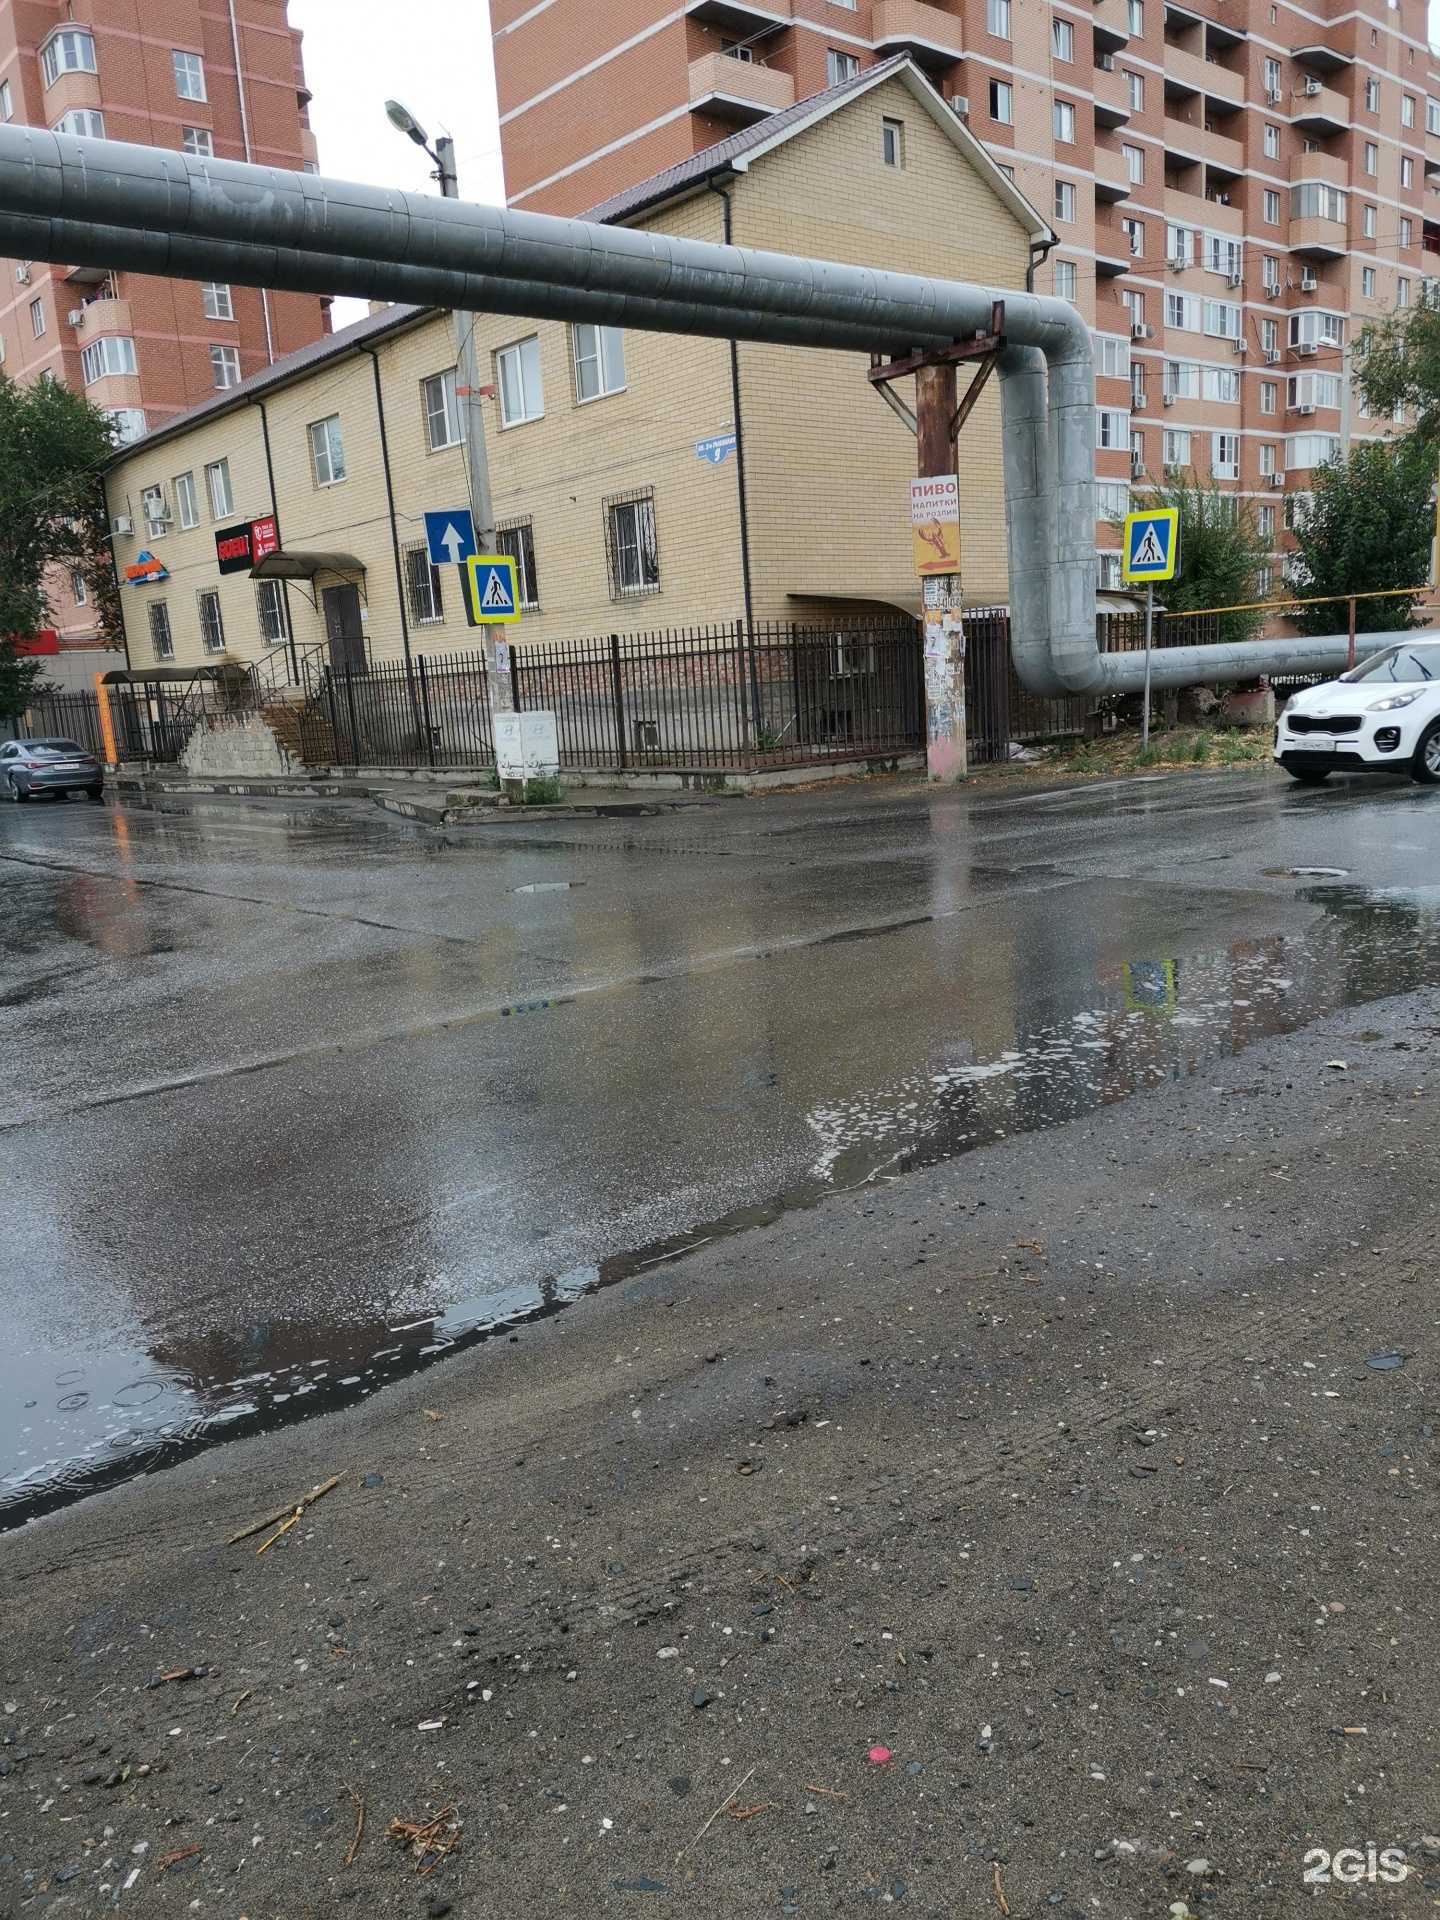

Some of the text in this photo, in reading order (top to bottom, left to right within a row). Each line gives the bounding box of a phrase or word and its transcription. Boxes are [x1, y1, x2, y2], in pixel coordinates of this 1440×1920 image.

[912, 482, 956, 497] ПИВО
[912, 498, 957, 510] НАПИТКИ
[913, 512, 924, 520] НА
